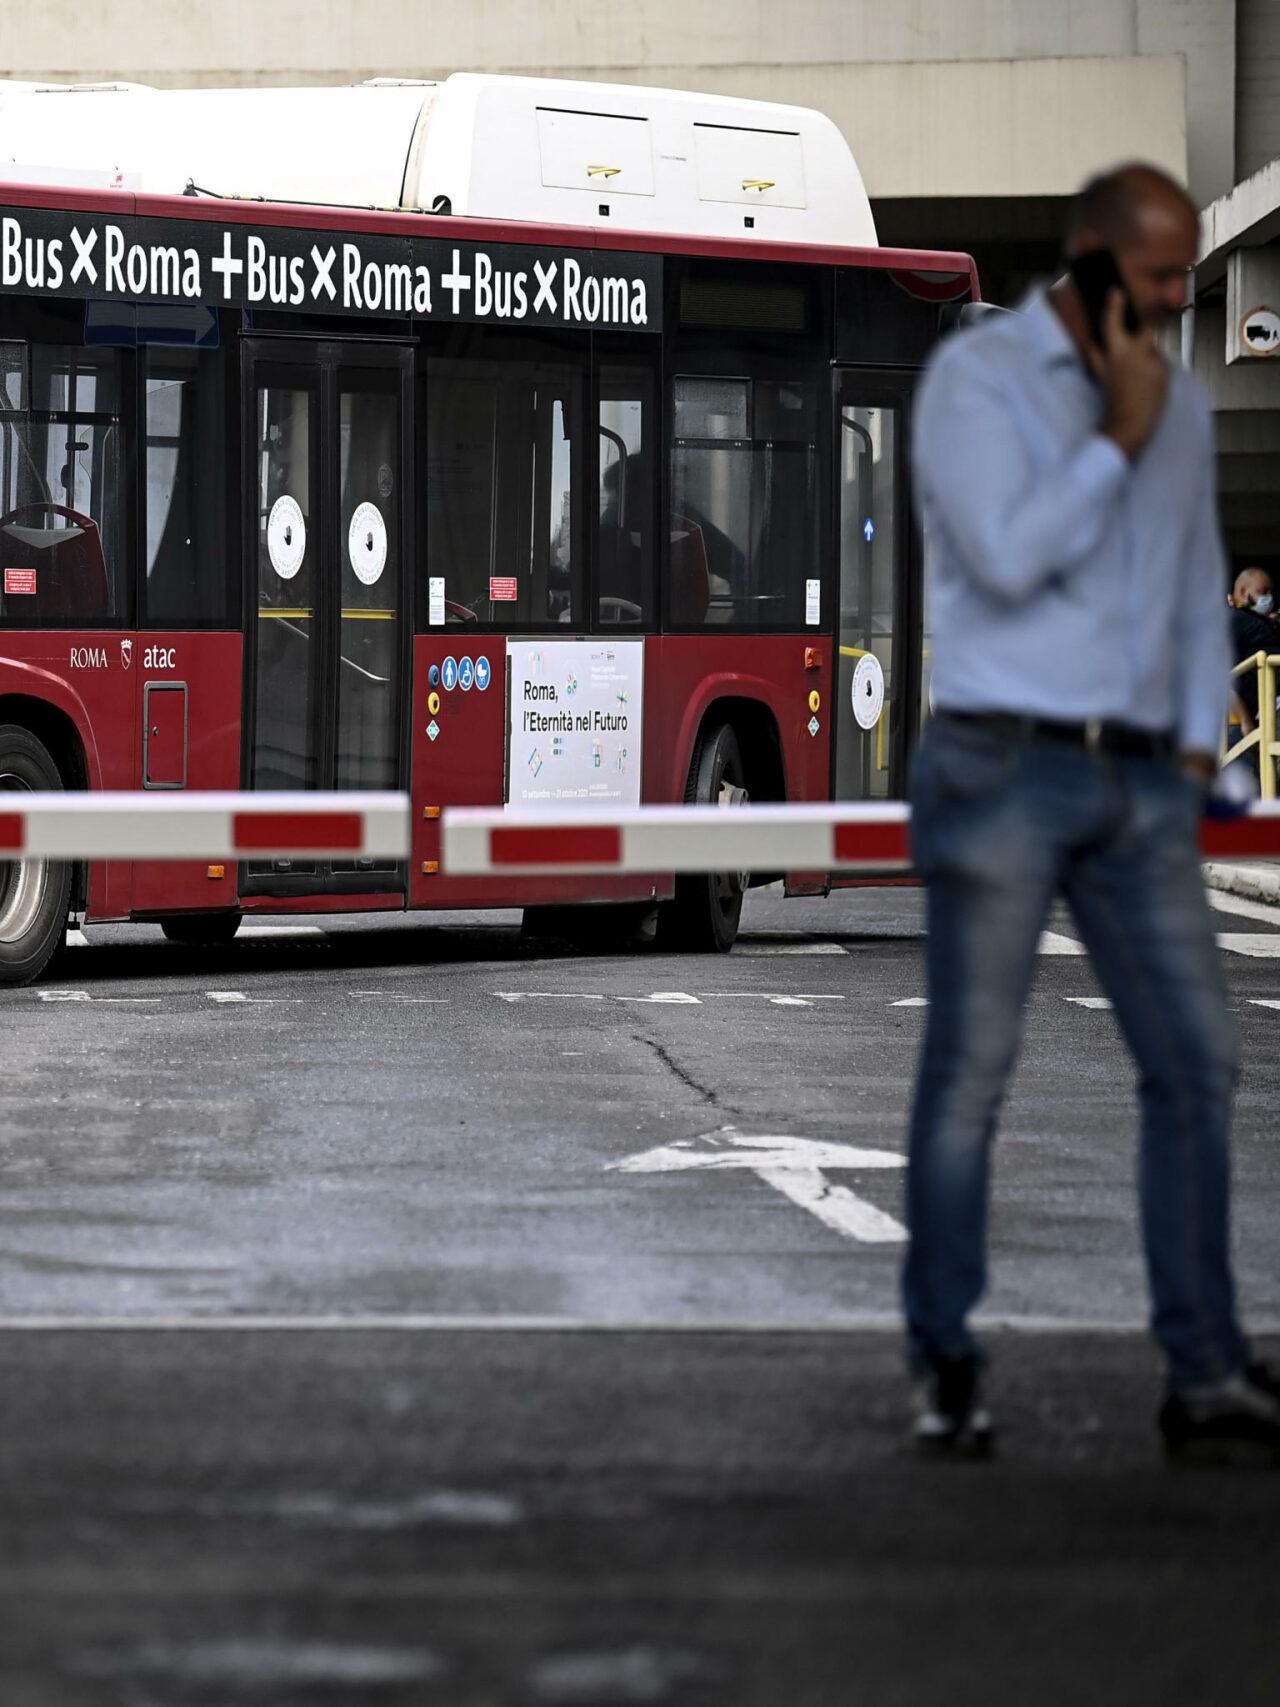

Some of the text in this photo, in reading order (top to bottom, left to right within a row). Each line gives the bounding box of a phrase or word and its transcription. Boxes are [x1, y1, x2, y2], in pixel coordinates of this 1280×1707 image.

[70, 644, 176, 669] ROMA atac
[523, 680, 559, 703] Roma,
[575, 710, 592, 731] nel
[594, 711, 628, 731] Futuro
